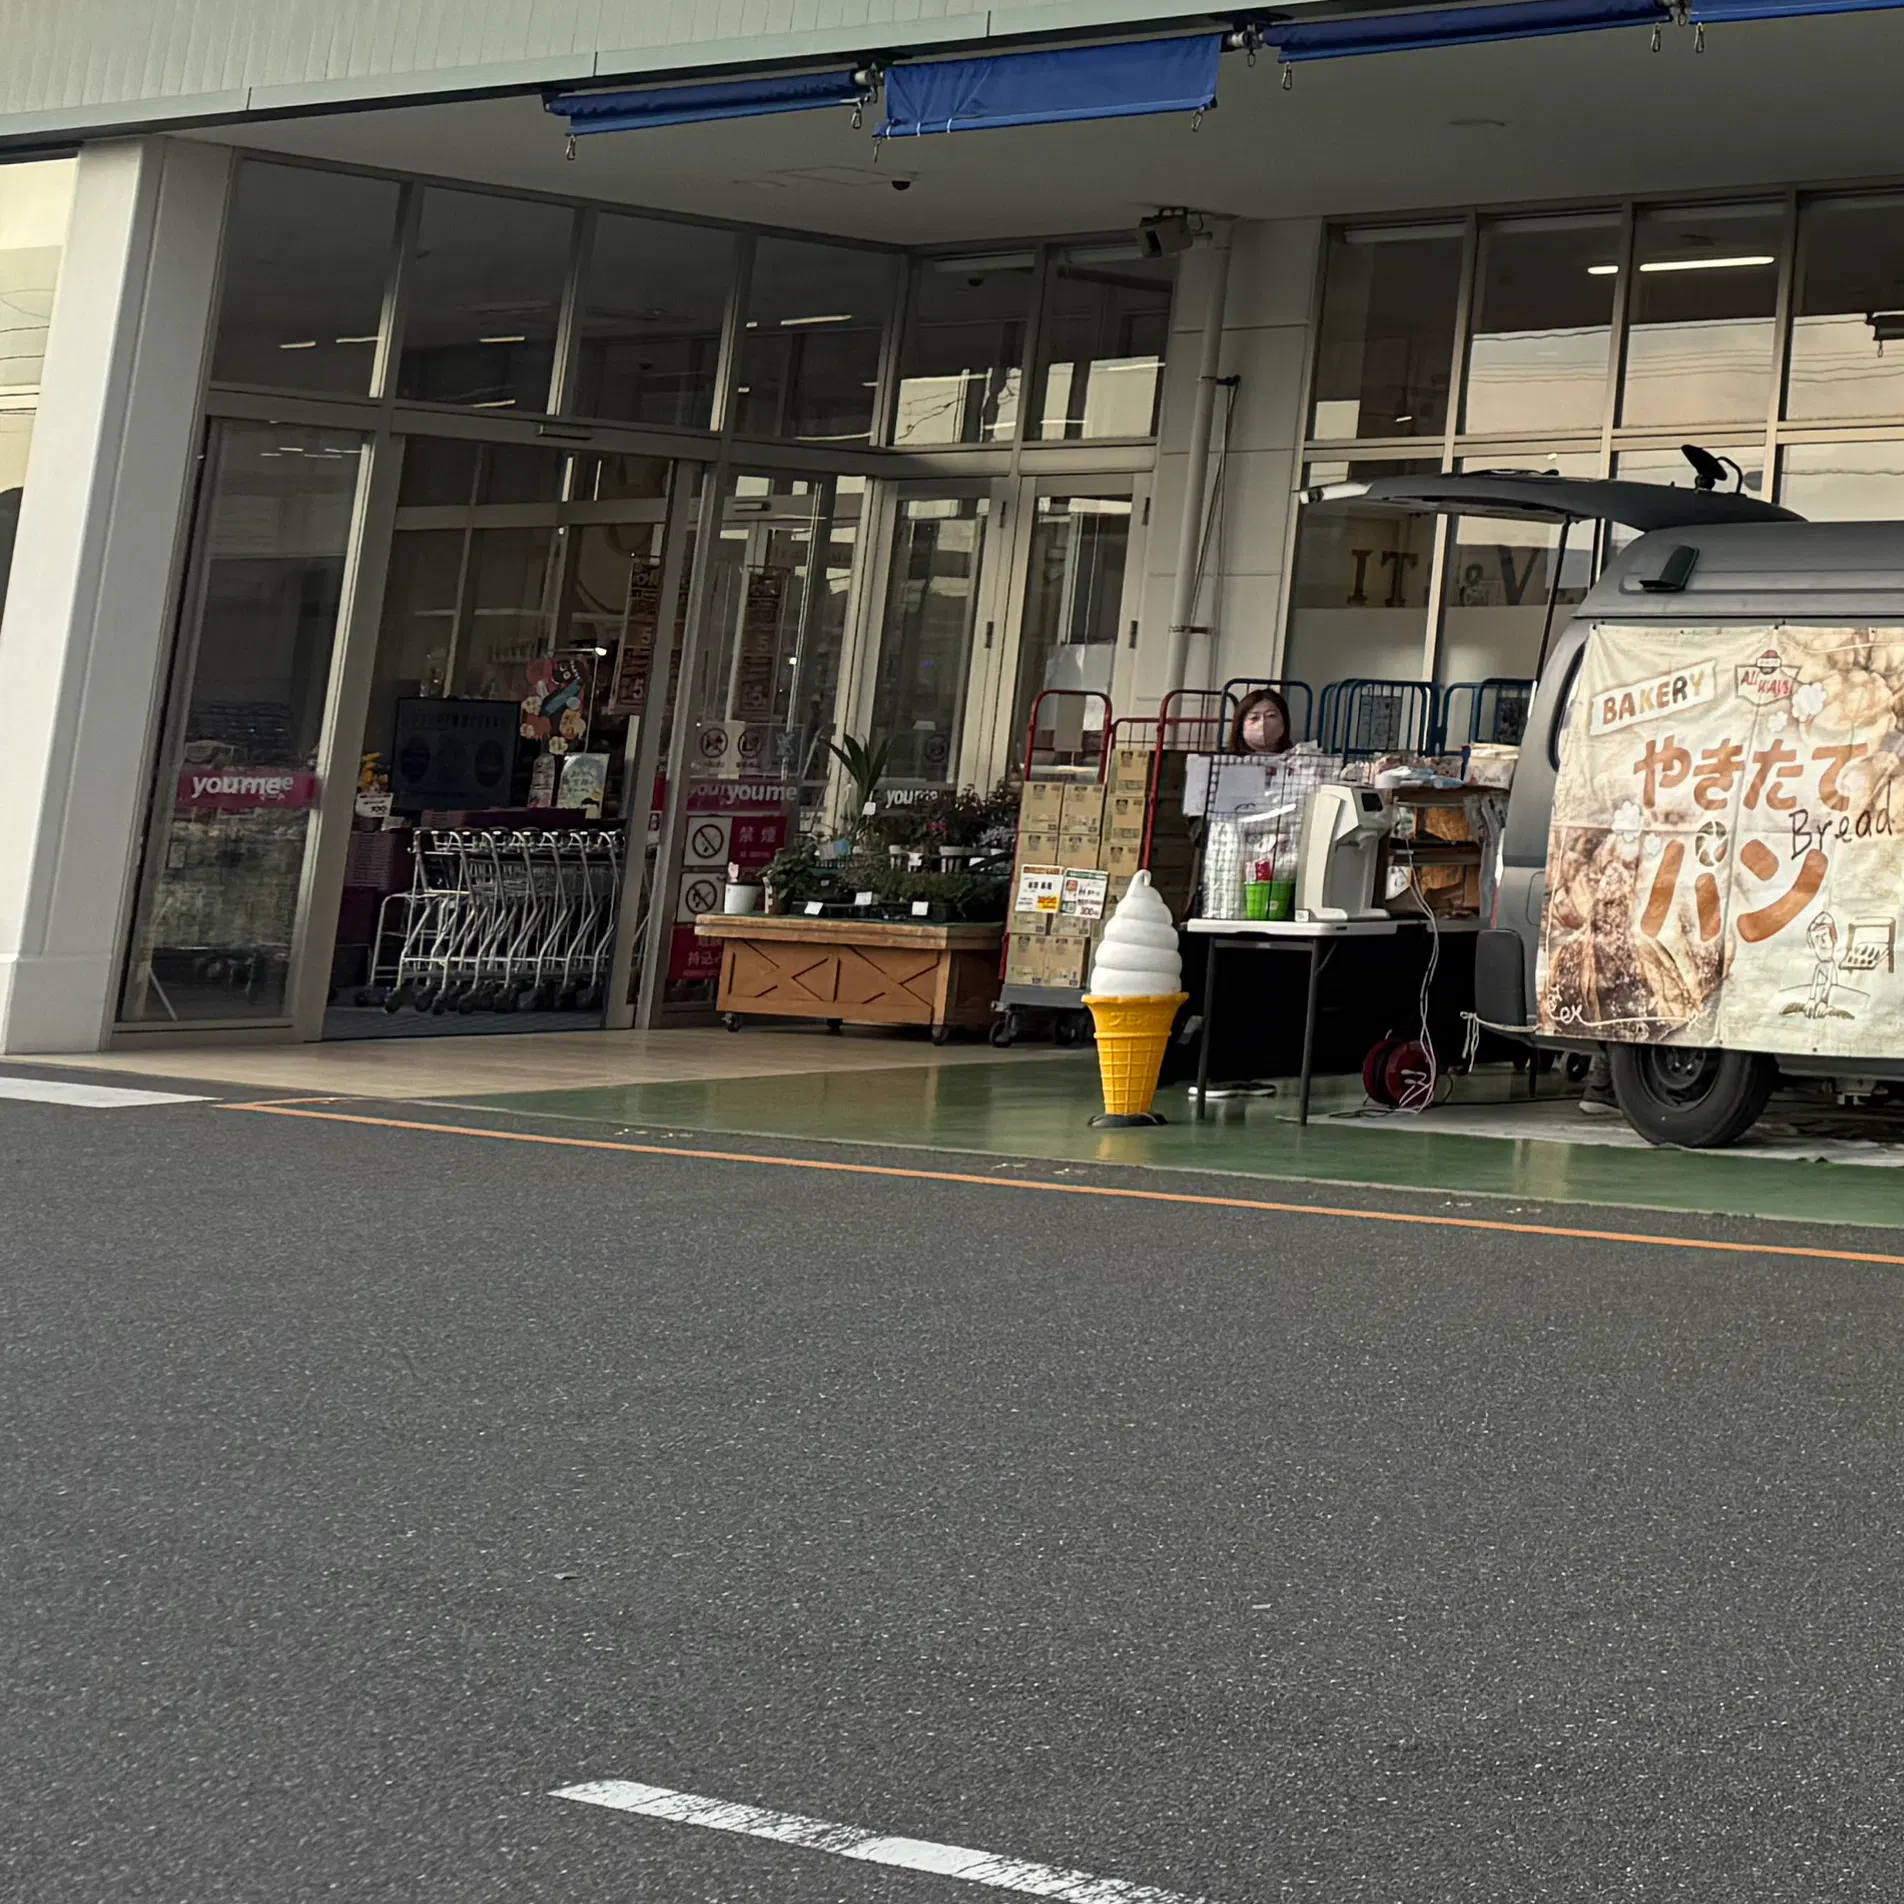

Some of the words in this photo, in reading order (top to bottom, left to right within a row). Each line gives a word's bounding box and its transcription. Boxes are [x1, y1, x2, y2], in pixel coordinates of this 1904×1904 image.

[1347, 548, 1433, 607] IT
[1602, 670, 1705, 726] BAKERY
[726, 782, 798, 805] youme
[1633, 734, 1868, 812] やきたて
[1788, 778, 1893, 861] Bread
[1640, 820, 1829, 944] パン
